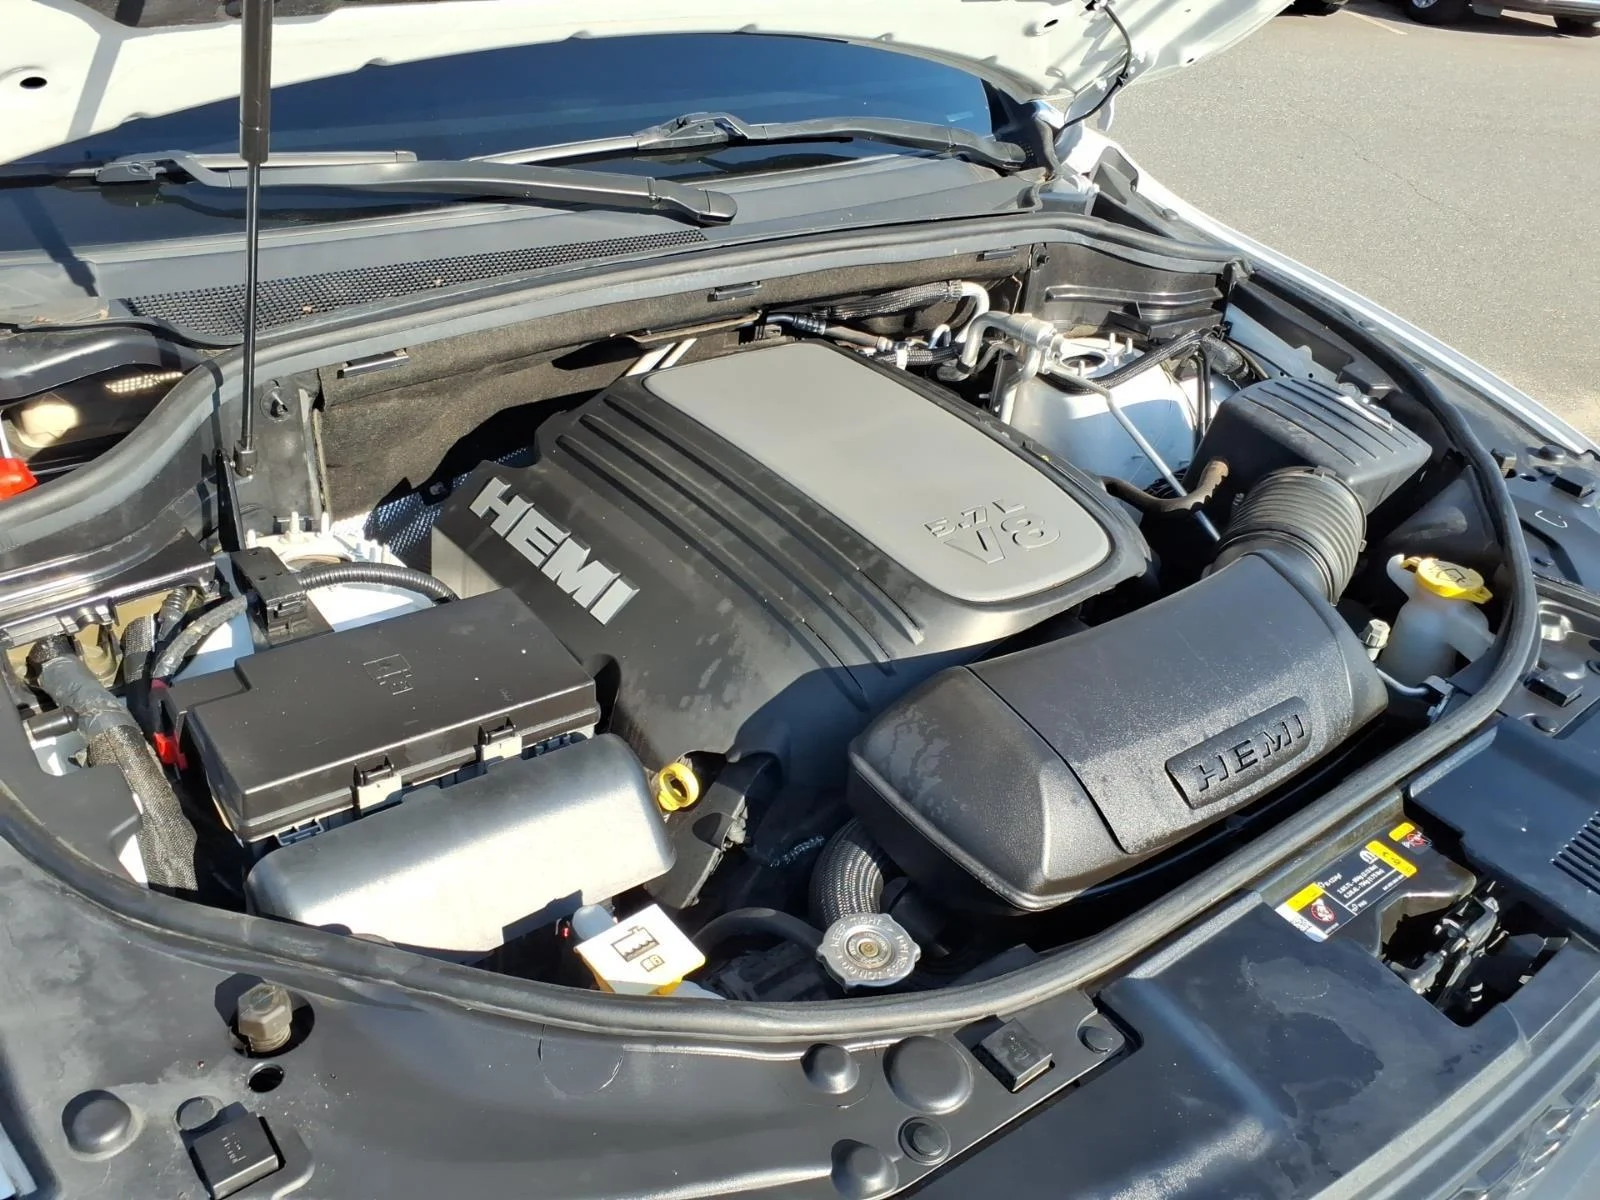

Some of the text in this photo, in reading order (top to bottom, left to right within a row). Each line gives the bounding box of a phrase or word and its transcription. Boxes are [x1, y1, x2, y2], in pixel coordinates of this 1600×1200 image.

[469, 477, 641, 626] HEMI
[943, 514, 1061, 565] V8
[1191, 714, 1305, 792] HEMI
